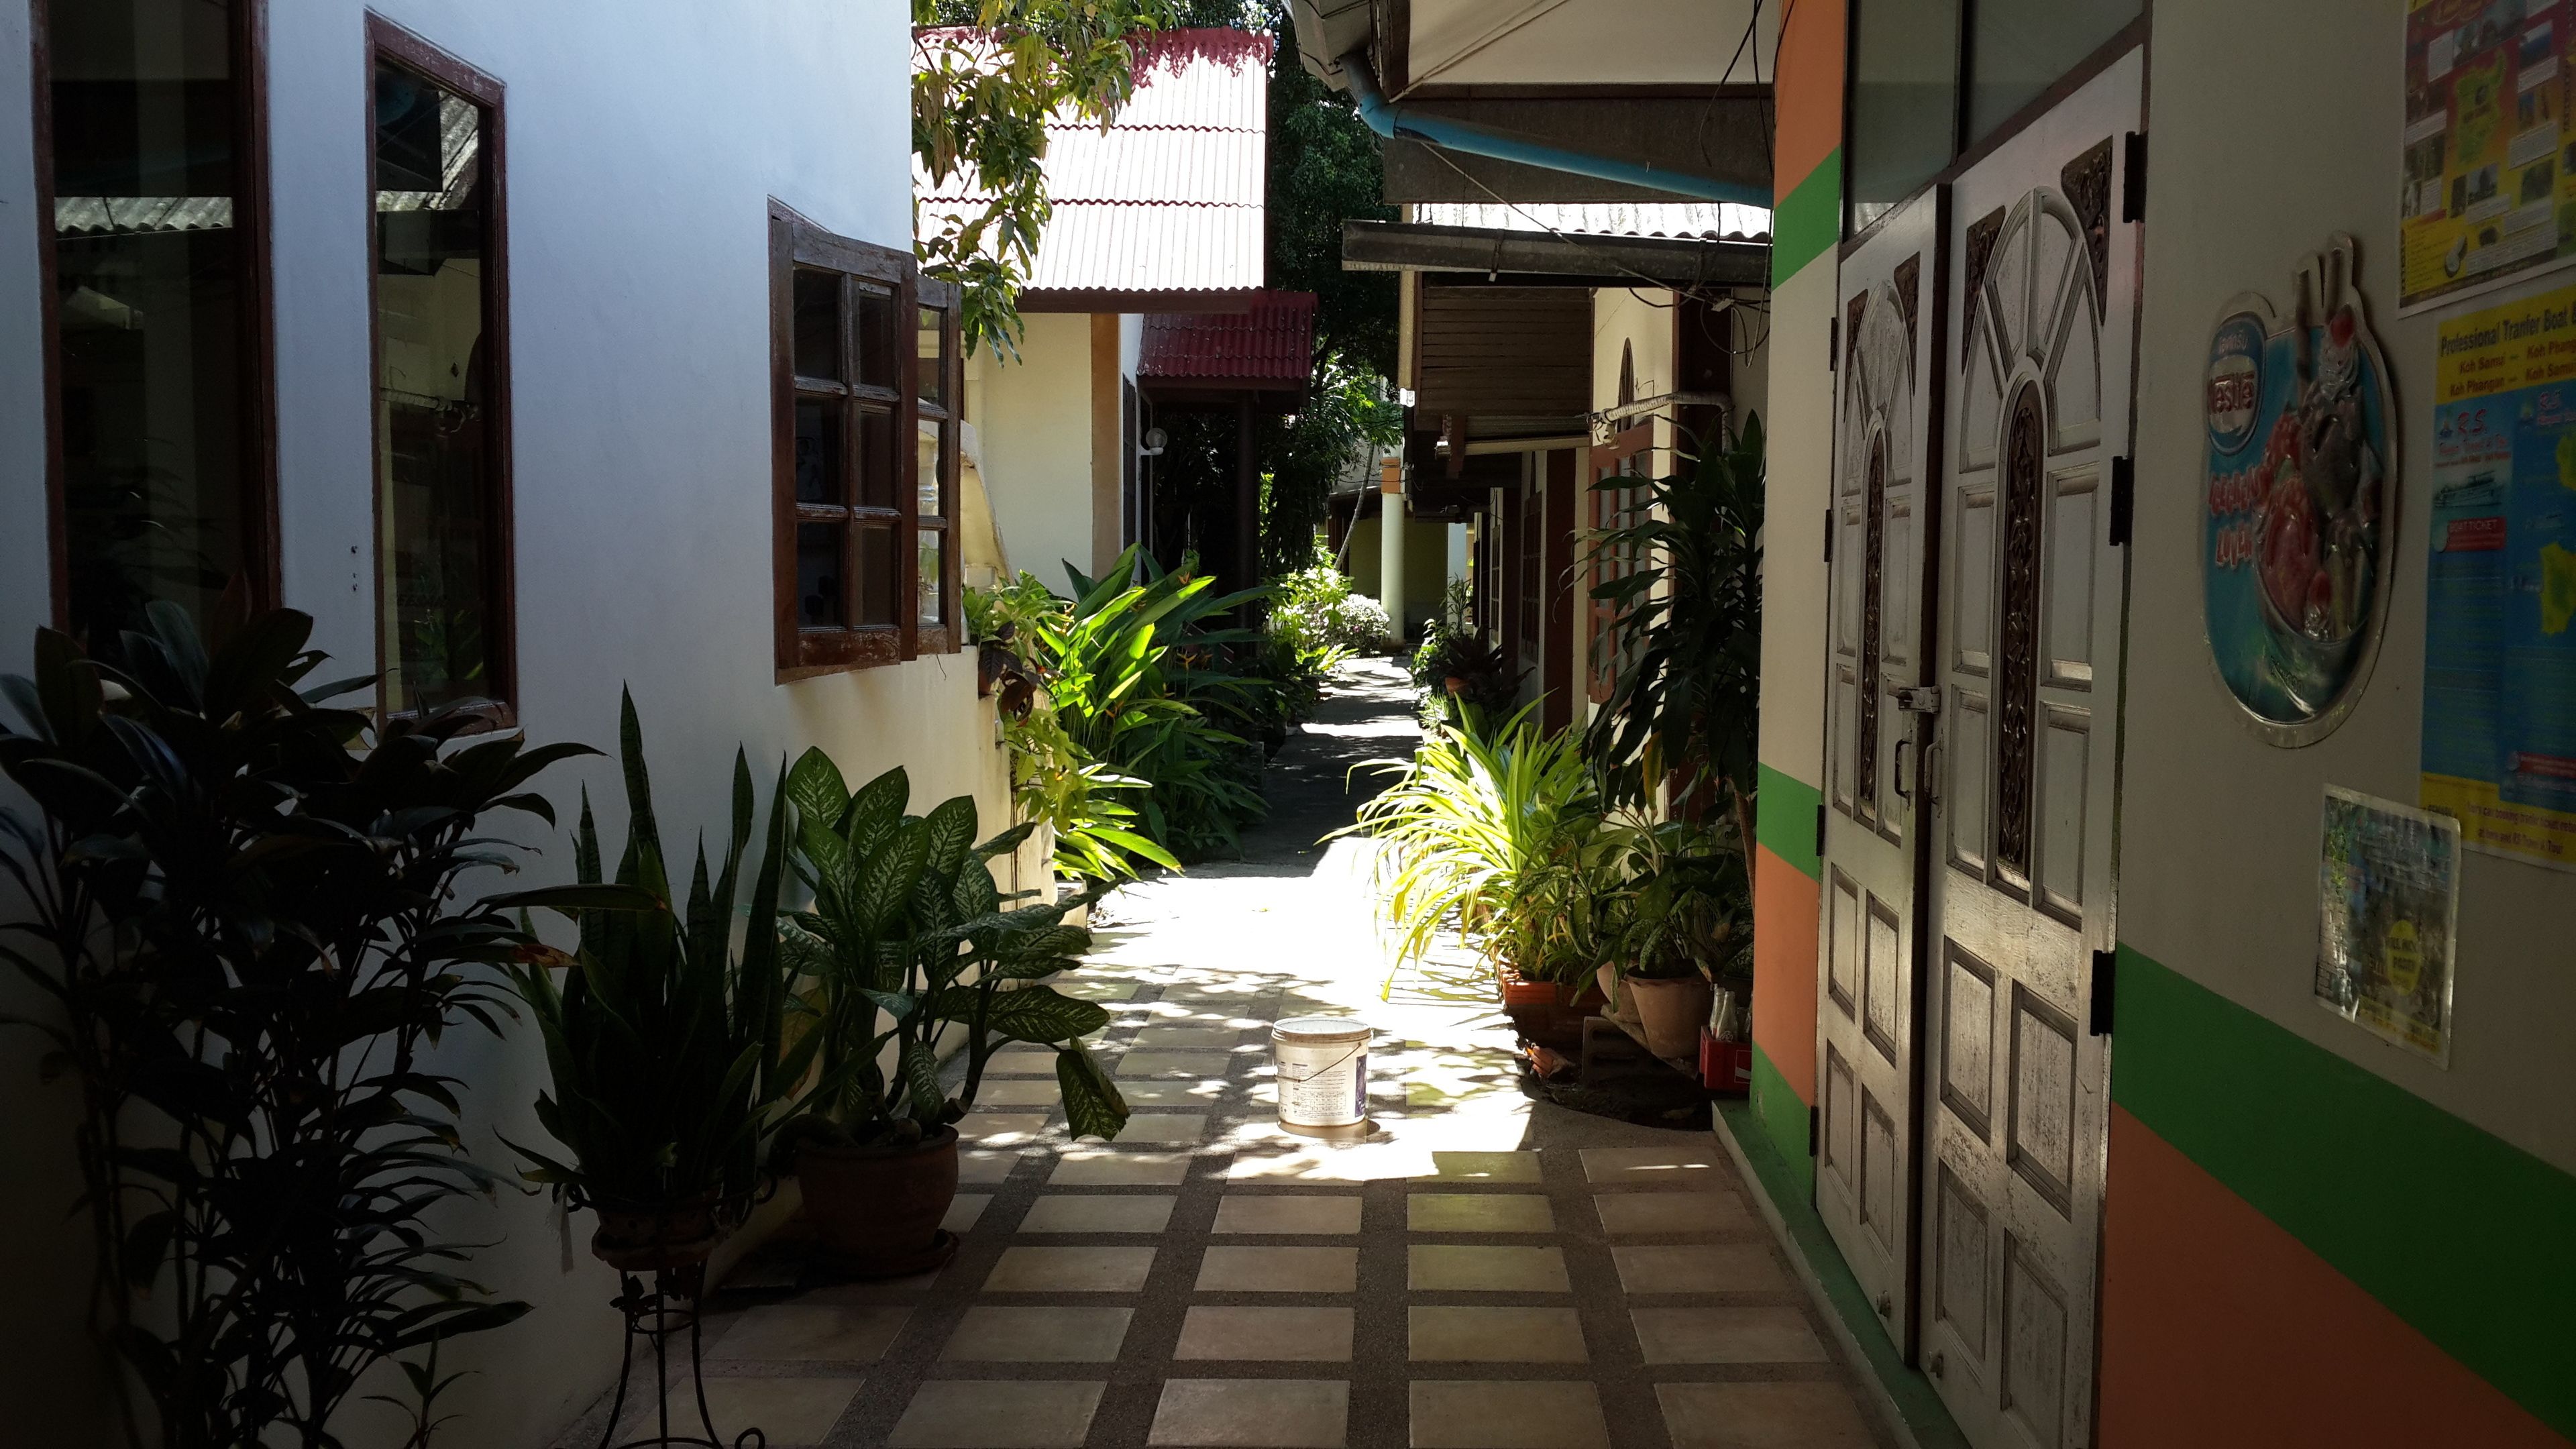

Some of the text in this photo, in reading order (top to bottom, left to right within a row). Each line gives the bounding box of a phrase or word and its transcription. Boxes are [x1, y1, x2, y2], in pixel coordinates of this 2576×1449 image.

[2440, 321, 2500, 357] Professional
[2543, 304, 2568, 333] Boat
[2459, 360, 2476, 376] Koh
[2526, 343, 2546, 360] Koh
[2451, 382, 2465, 397] Koh
[2526, 365, 2545, 382] Koh
